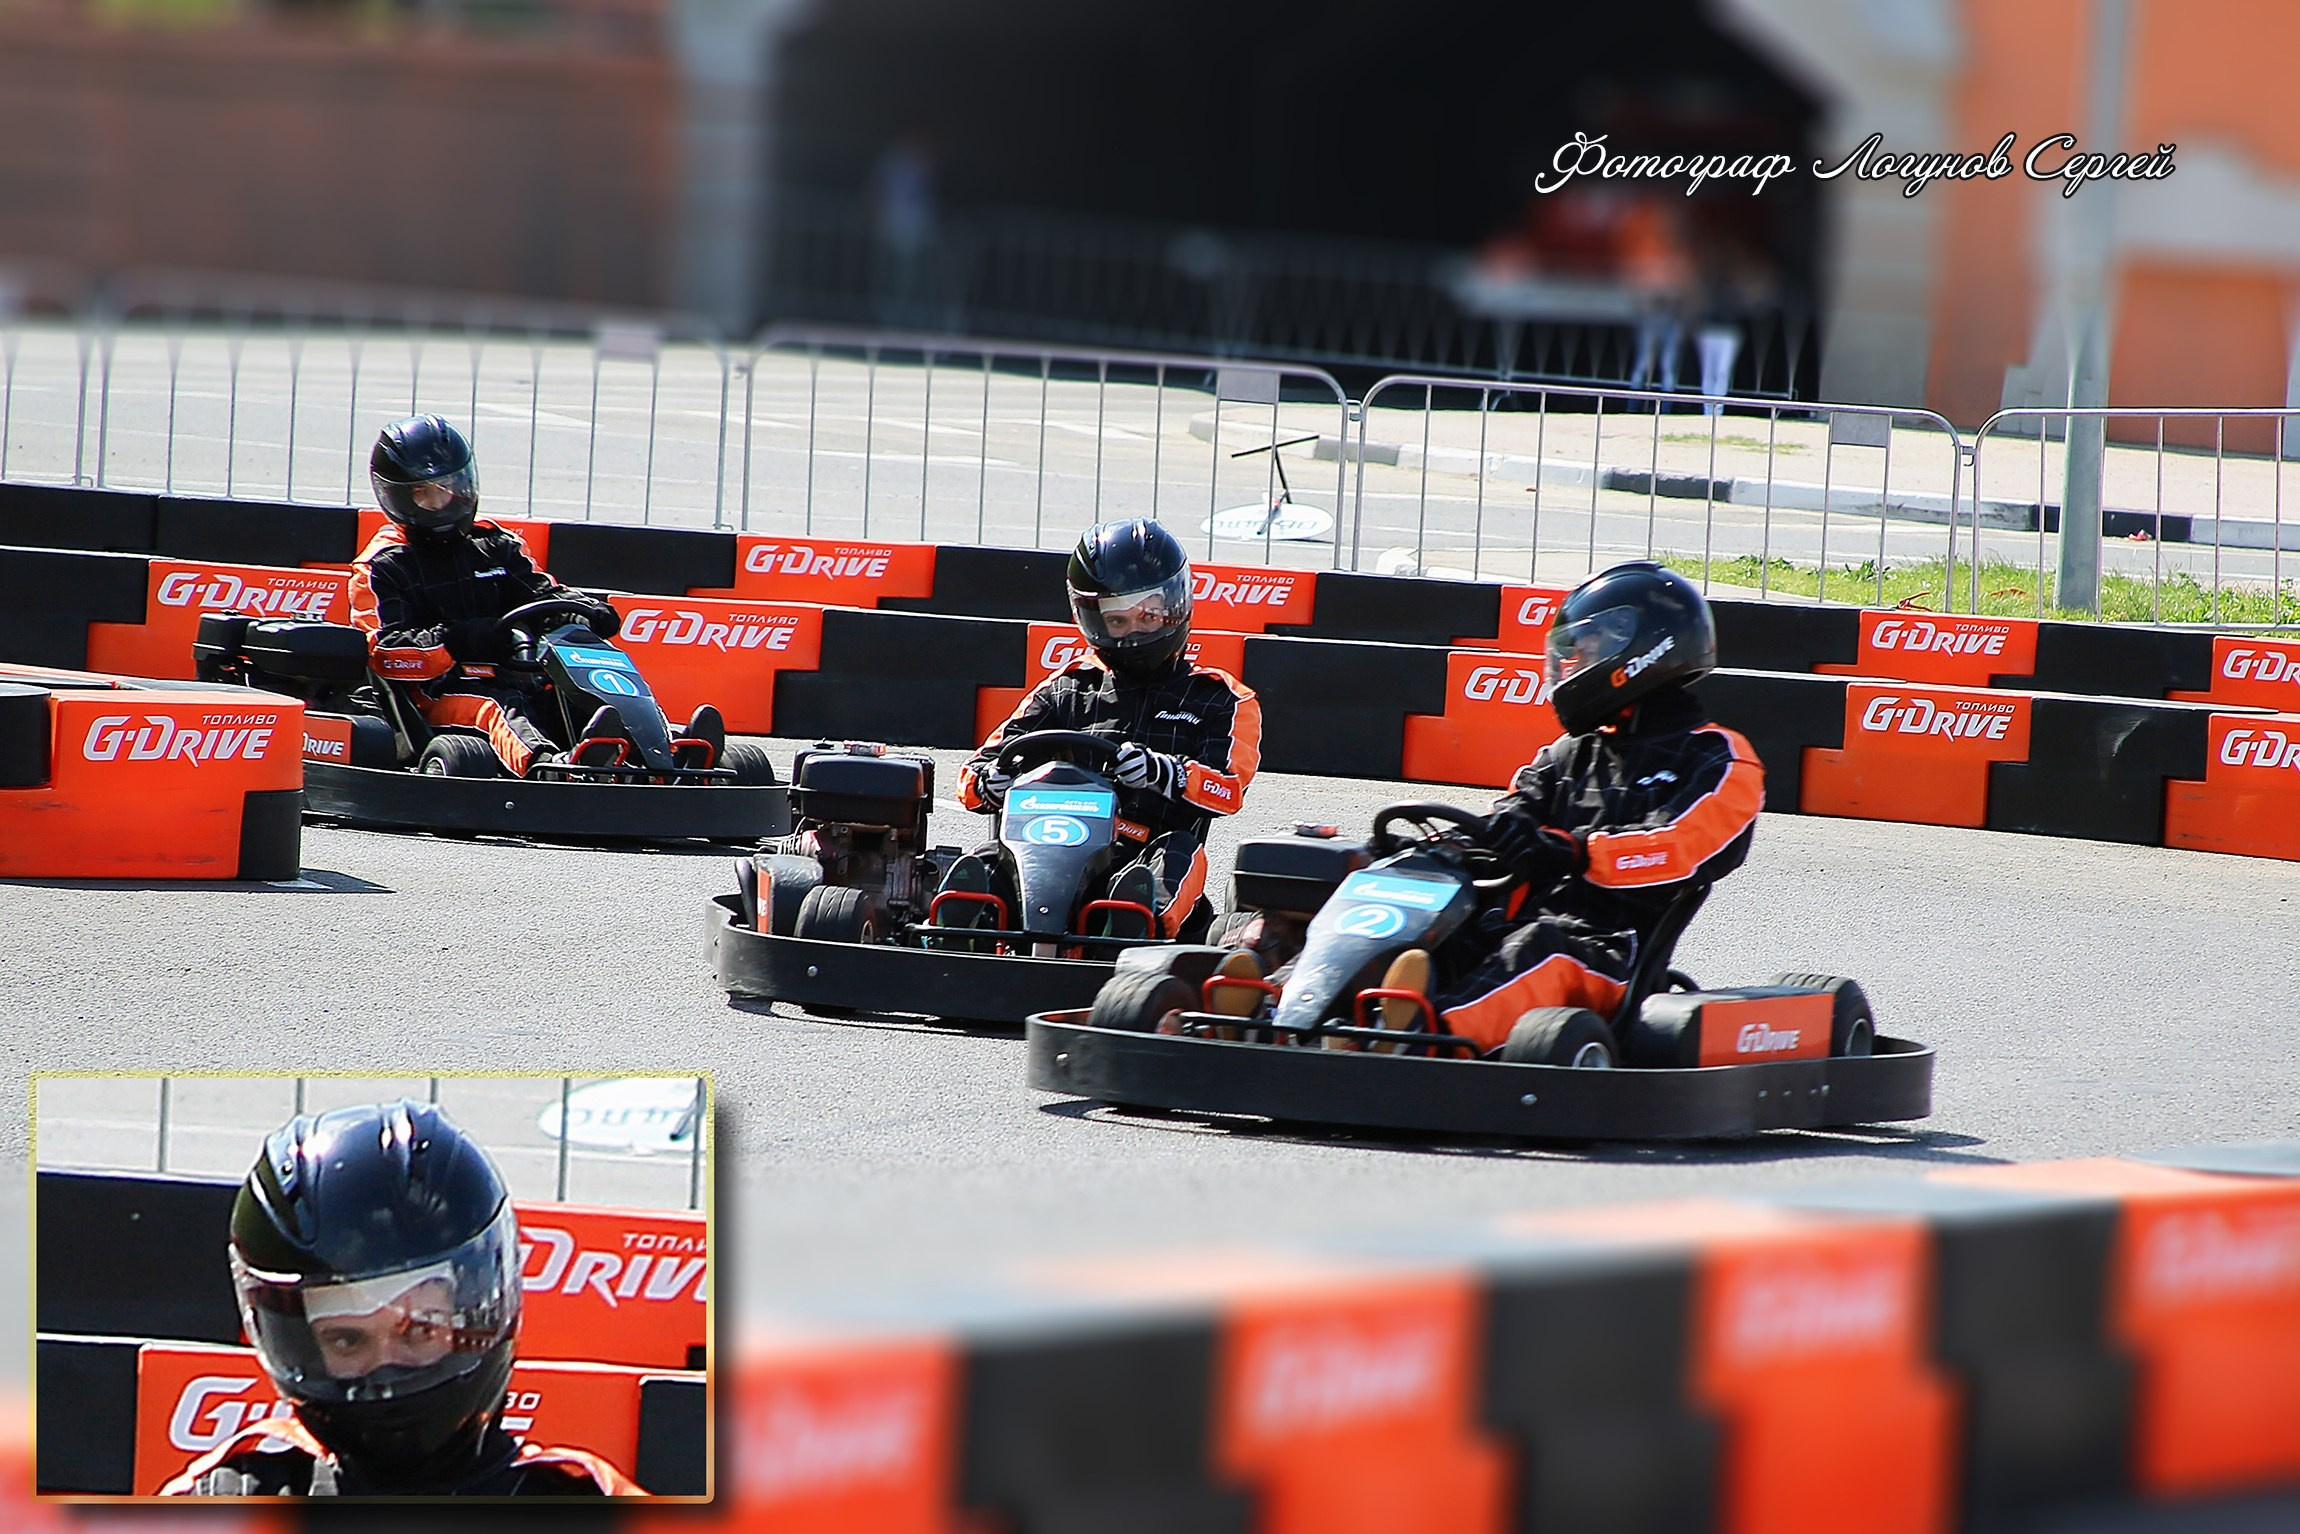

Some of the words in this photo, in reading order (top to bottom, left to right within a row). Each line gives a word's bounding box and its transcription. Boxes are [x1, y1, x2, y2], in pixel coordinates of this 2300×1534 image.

[834, 547, 892, 557] ТОПЛИВО
[1236, 574, 1295, 585] ТОПЛИВО
[728, 613, 799, 625] ТОПЛИВО
[1955, 623, 2010, 634] ТОПЛИВО
[602, 673, 627, 695] 1
[1955, 701, 2016, 713] ТОПЛИВО
[202, 714, 277, 725] ТОПЛИВО
[1040, 818, 1070, 844] 5
[1342, 908, 1390, 937] 2
